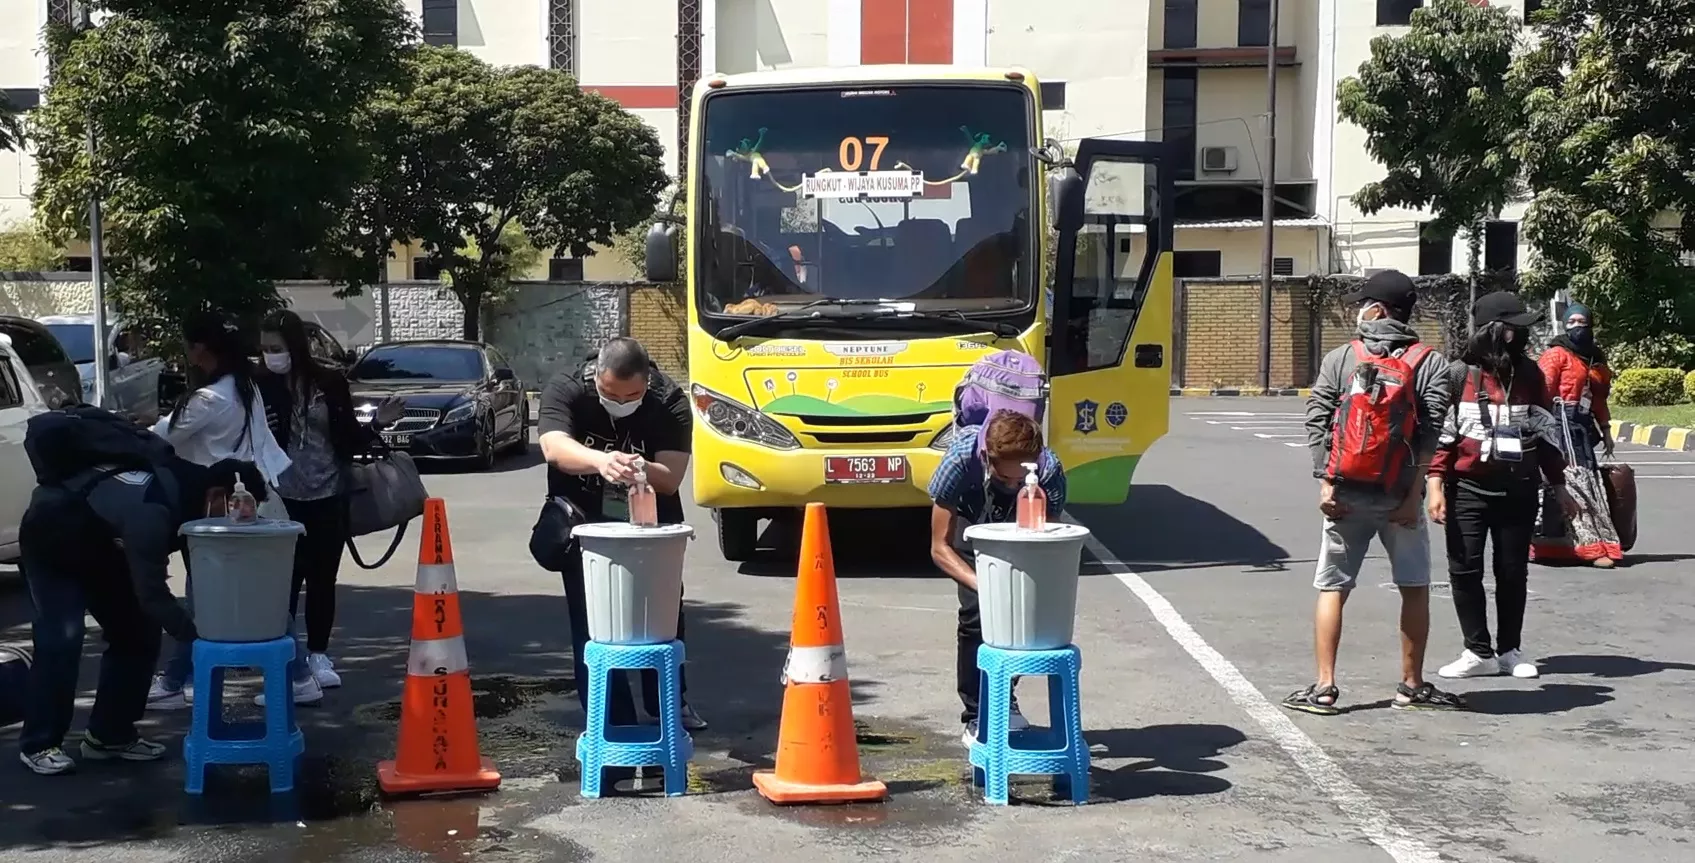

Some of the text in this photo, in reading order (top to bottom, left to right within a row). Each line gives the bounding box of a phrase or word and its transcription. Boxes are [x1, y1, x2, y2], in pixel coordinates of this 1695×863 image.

[839, 136, 889, 171] 07
[806, 178, 842, 192] RUNGKUT
[848, 177, 875, 191] WIJAYA
[876, 177, 908, 190] KUSUMA
[910, 177, 920, 190] PP
[840, 356, 894, 366] BIS SEKOLAH
[842, 369, 889, 378] SCHOOL BUS
[827, 457, 902, 472] L 7563 NP
